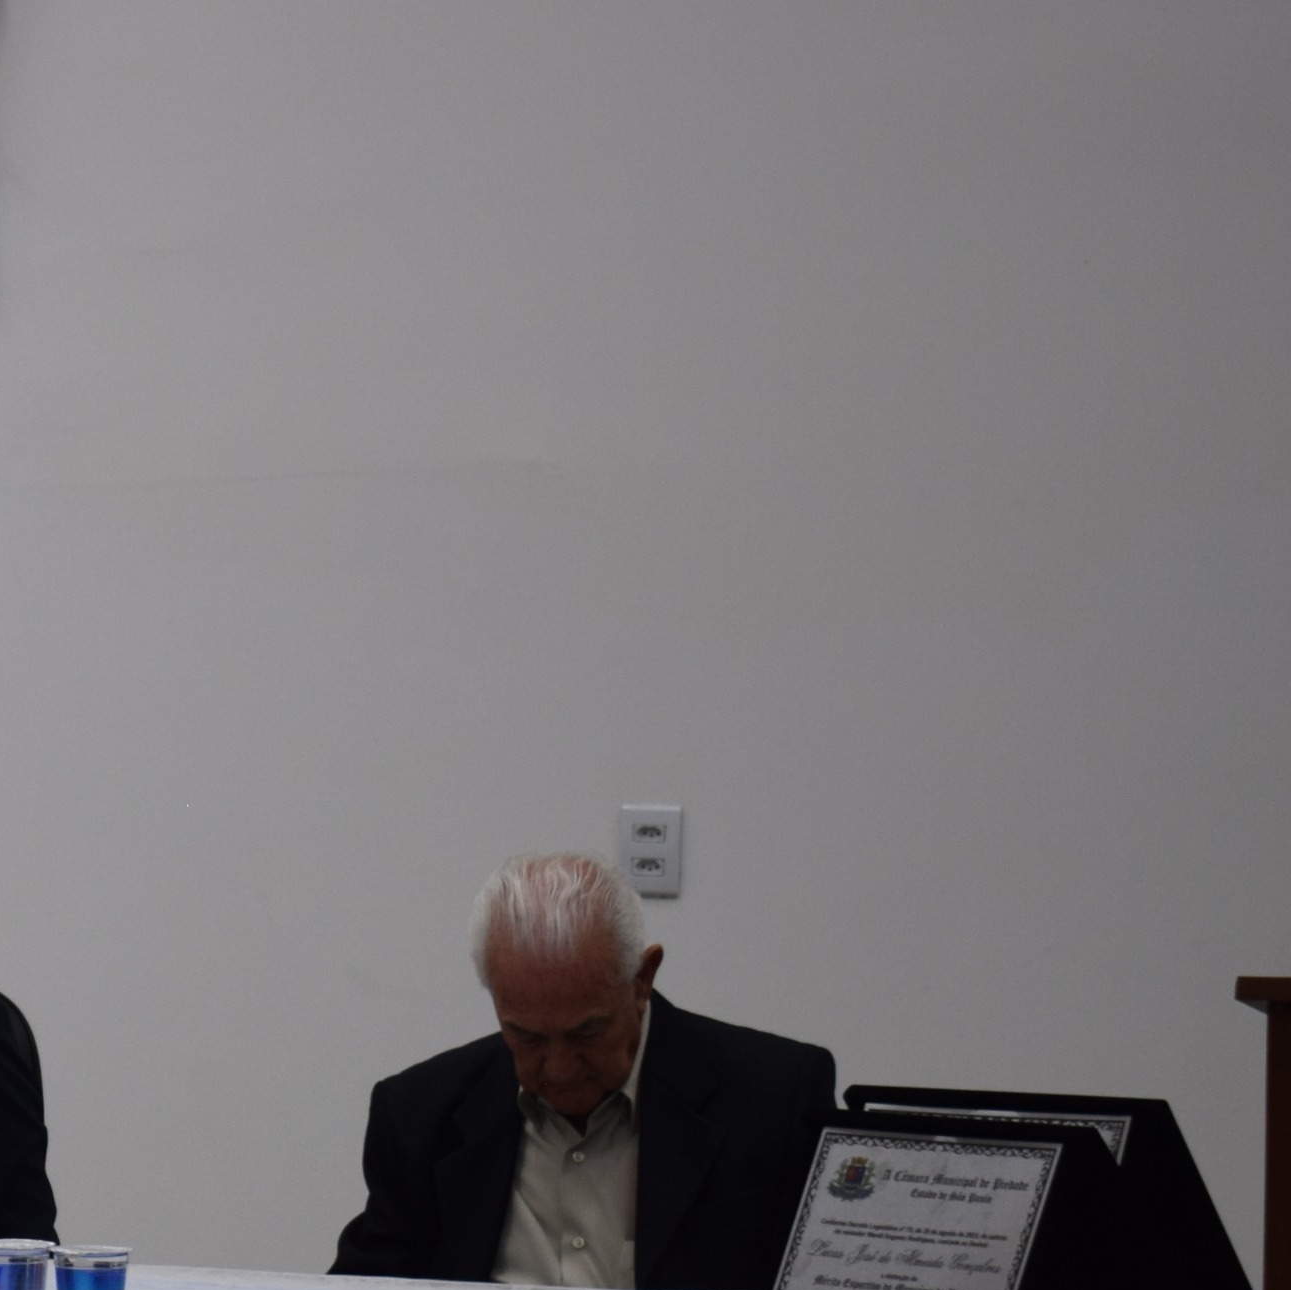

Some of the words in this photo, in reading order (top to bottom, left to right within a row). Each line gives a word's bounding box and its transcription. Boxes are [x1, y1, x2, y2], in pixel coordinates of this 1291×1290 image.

[882, 1169, 892, 1181] A
[894, 1170, 929, 1184] Câmara
[930, 1173, 978, 1188] Municipal
[979, 1178, 989, 1188] de
[993, 1178, 1029, 1191] Piedade
[910, 1188, 937, 1199] Estado
[938, 1191, 947, 1200] de
